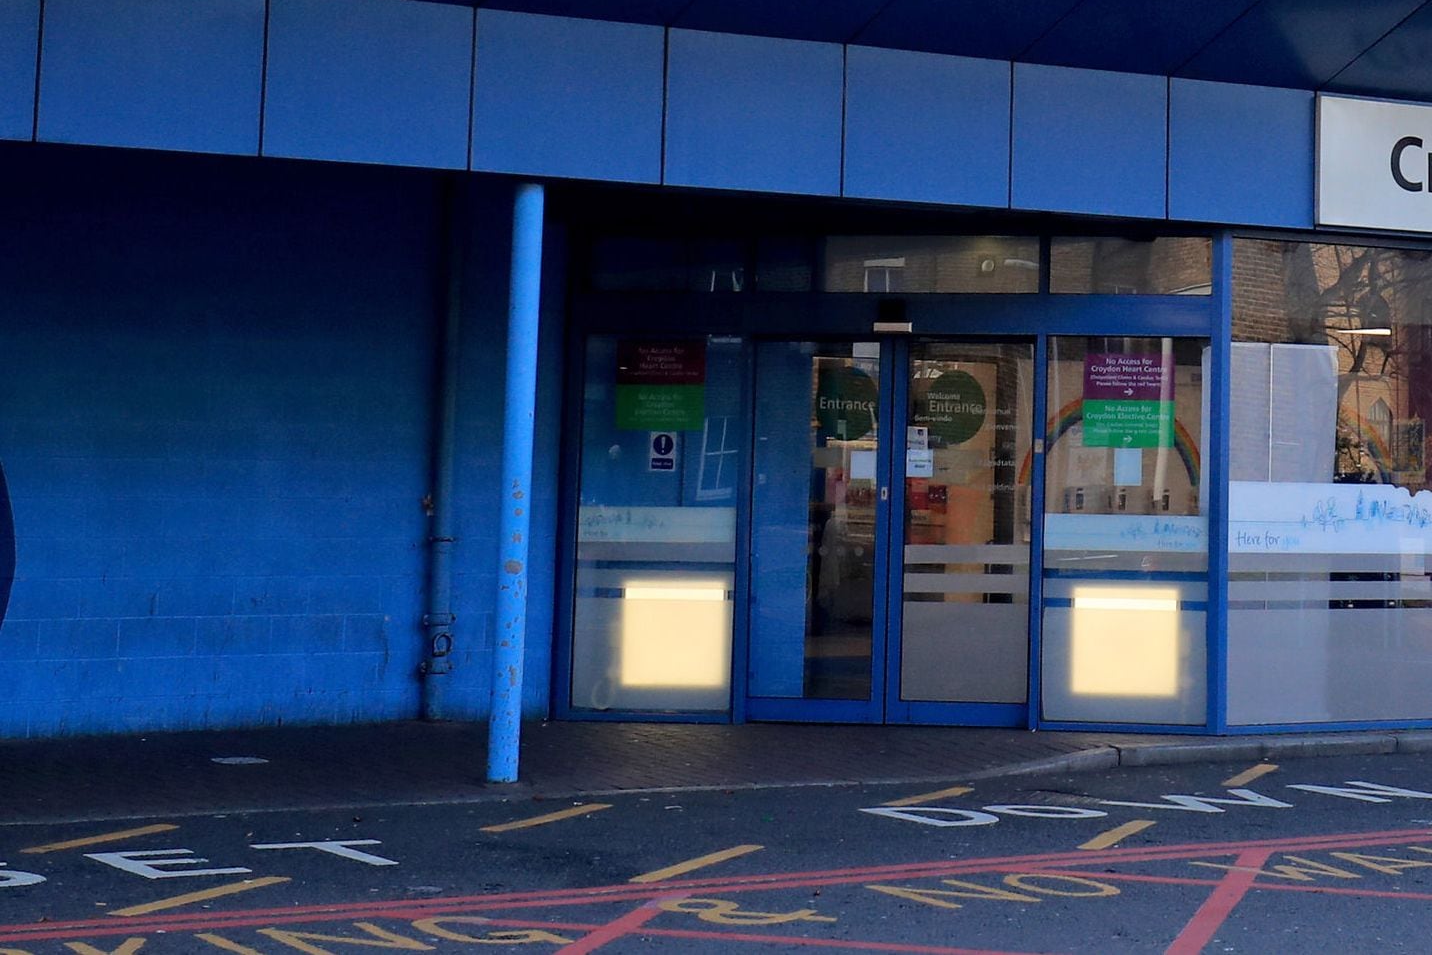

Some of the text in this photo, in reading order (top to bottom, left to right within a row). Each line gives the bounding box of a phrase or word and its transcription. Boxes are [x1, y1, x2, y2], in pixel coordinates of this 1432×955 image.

[1091, 365, 1121, 374] Croydon
[819, 396, 876, 411] Entrance
[929, 401, 982, 414] Entrance
[1235, 531, 1262, 546] Here
[1264, 531, 1281, 548] for
[658, 898, 837, 925] &
[864, 874, 1120, 909] NO
